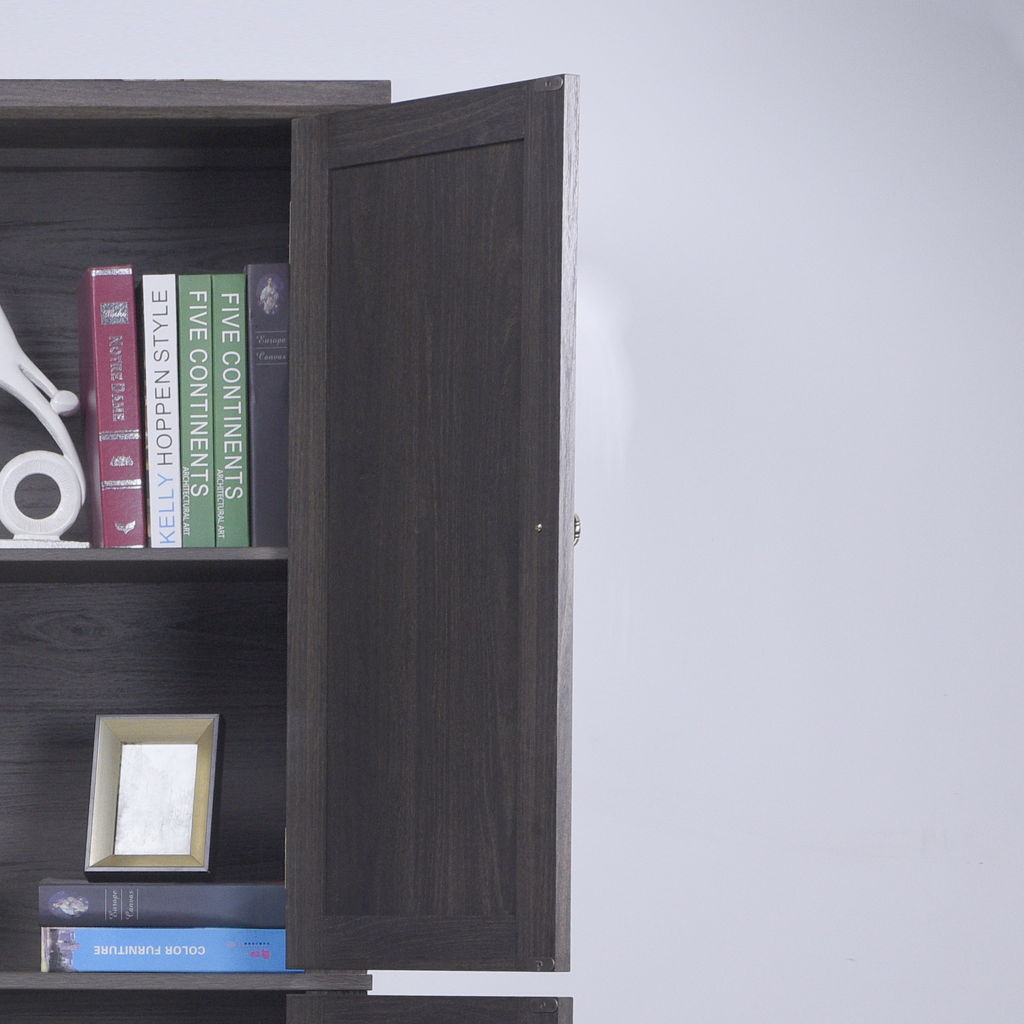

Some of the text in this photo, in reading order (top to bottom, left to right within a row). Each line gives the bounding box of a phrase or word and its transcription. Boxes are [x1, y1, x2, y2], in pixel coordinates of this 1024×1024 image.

[152, 290, 175, 544] KELLY HOPPEN STYLE
[189, 291, 209, 497] FIVE CONTINENTS
[221, 293, 243, 499] FIVE CONTINENTS
[182, 466, 190, 520] ARCHITECTURAL
[216, 469, 225, 538] ARCHITECTURAL ART
[93, 945, 205, 955] COLOR FURNITURE
